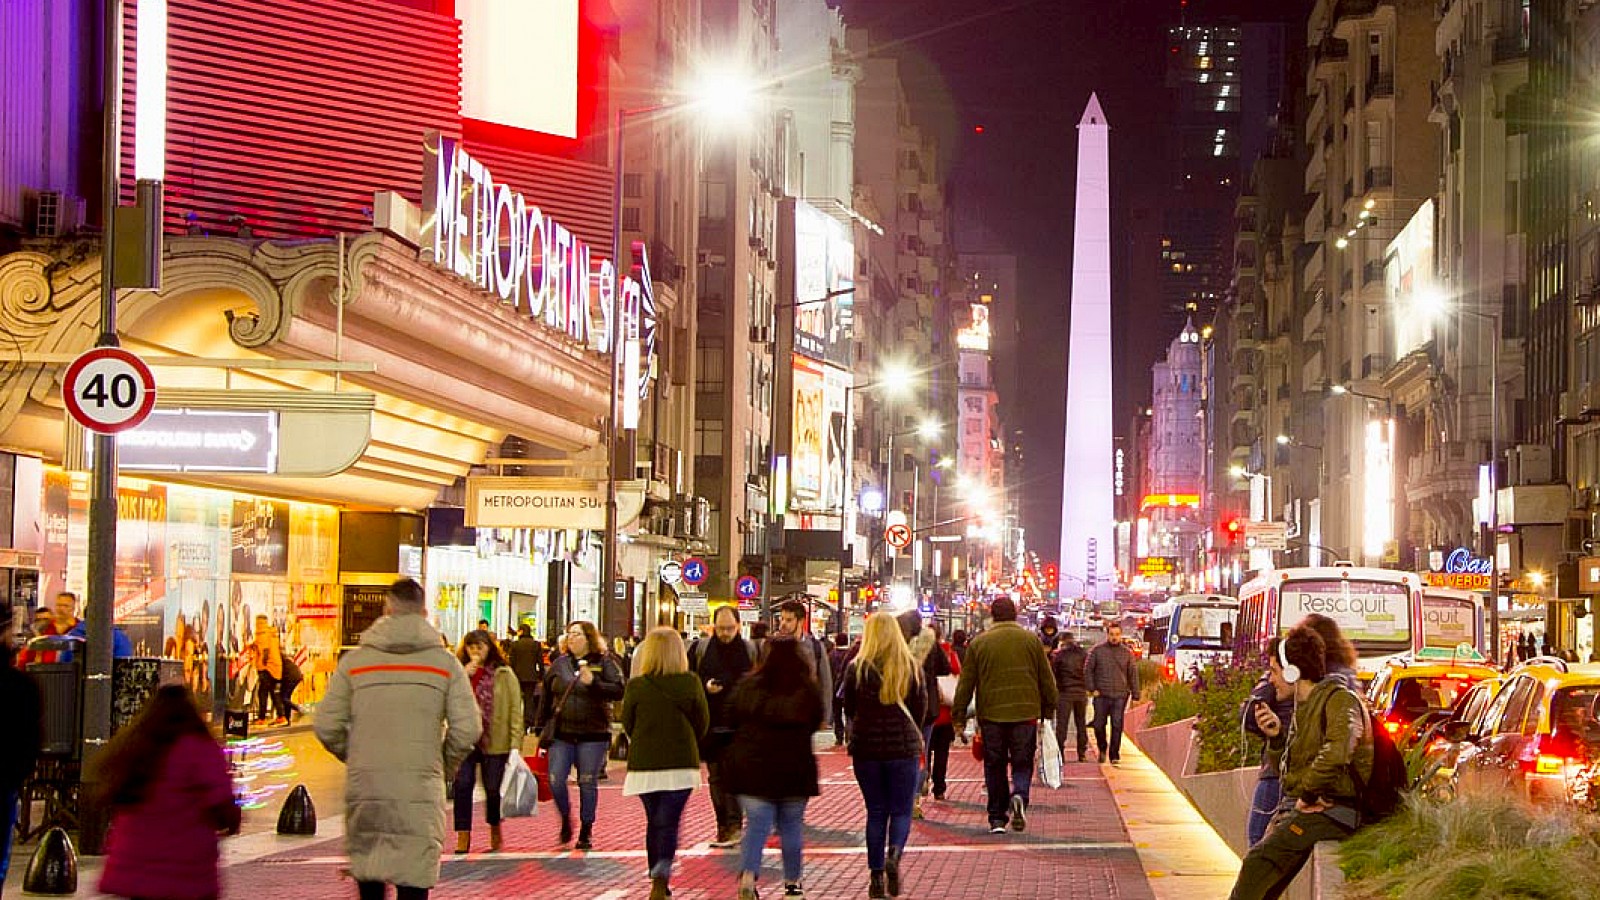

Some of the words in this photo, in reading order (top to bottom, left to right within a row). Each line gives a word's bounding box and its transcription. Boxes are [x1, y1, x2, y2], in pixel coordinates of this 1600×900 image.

[434, 134, 590, 345] METROPOLITAN
[82, 373, 137, 408] 40
[484, 496, 575, 509] METROPOLITAN
[1427, 574, 1444, 586] LA
[1299, 593, 1388, 616] Resaquit
